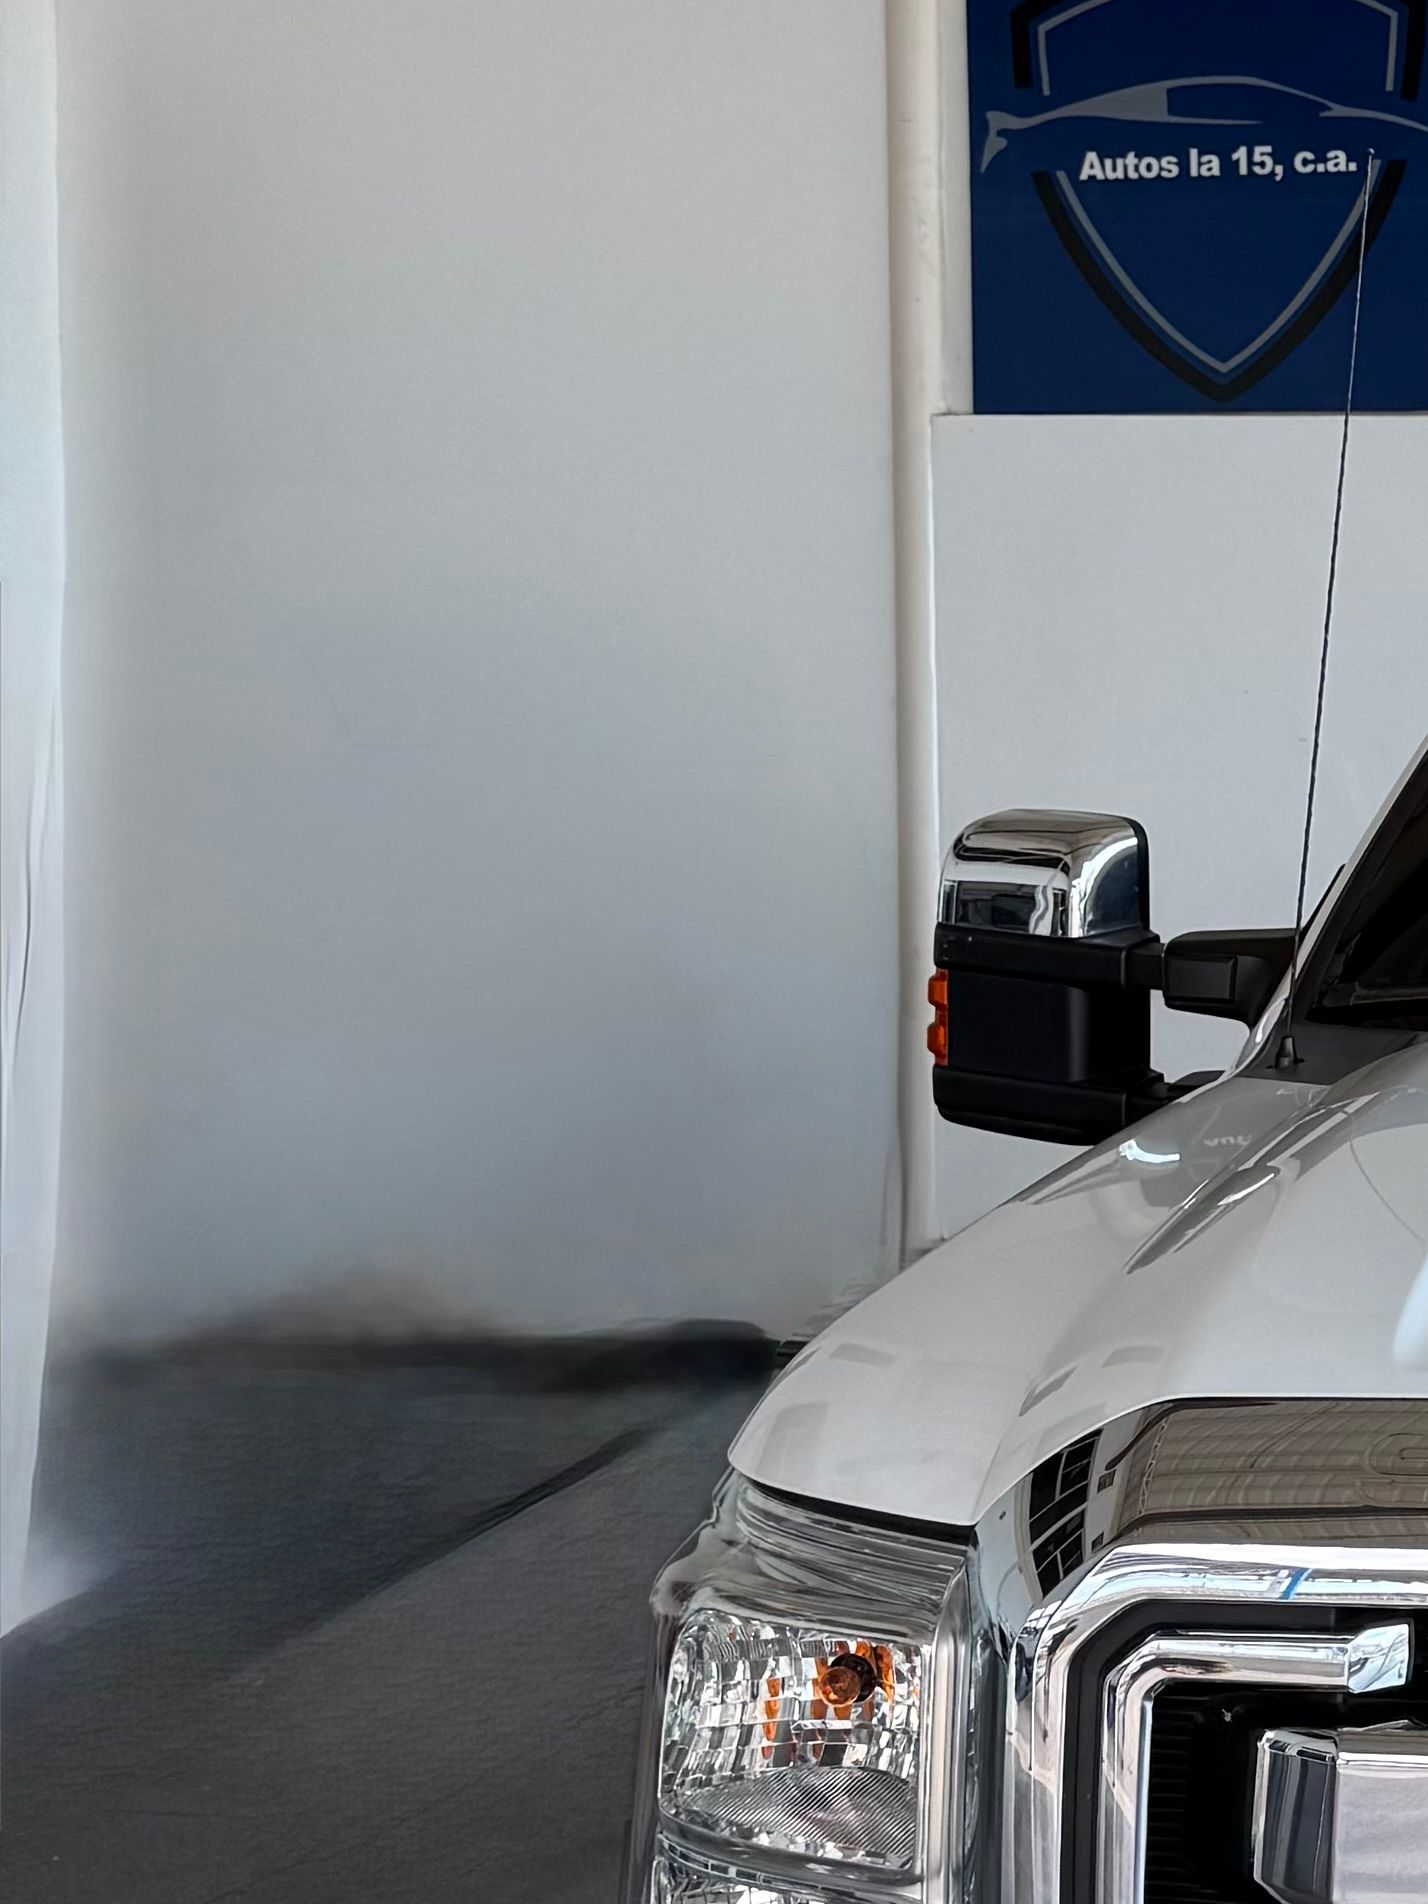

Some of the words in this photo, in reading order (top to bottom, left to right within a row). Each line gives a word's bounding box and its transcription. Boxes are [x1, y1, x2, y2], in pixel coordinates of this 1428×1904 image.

[1079, 151, 1180, 181] Autos
[1189, 148, 1221, 178] la
[1231, 145, 1284, 182] 15,
[1293, 149, 1357, 175] c.a.
